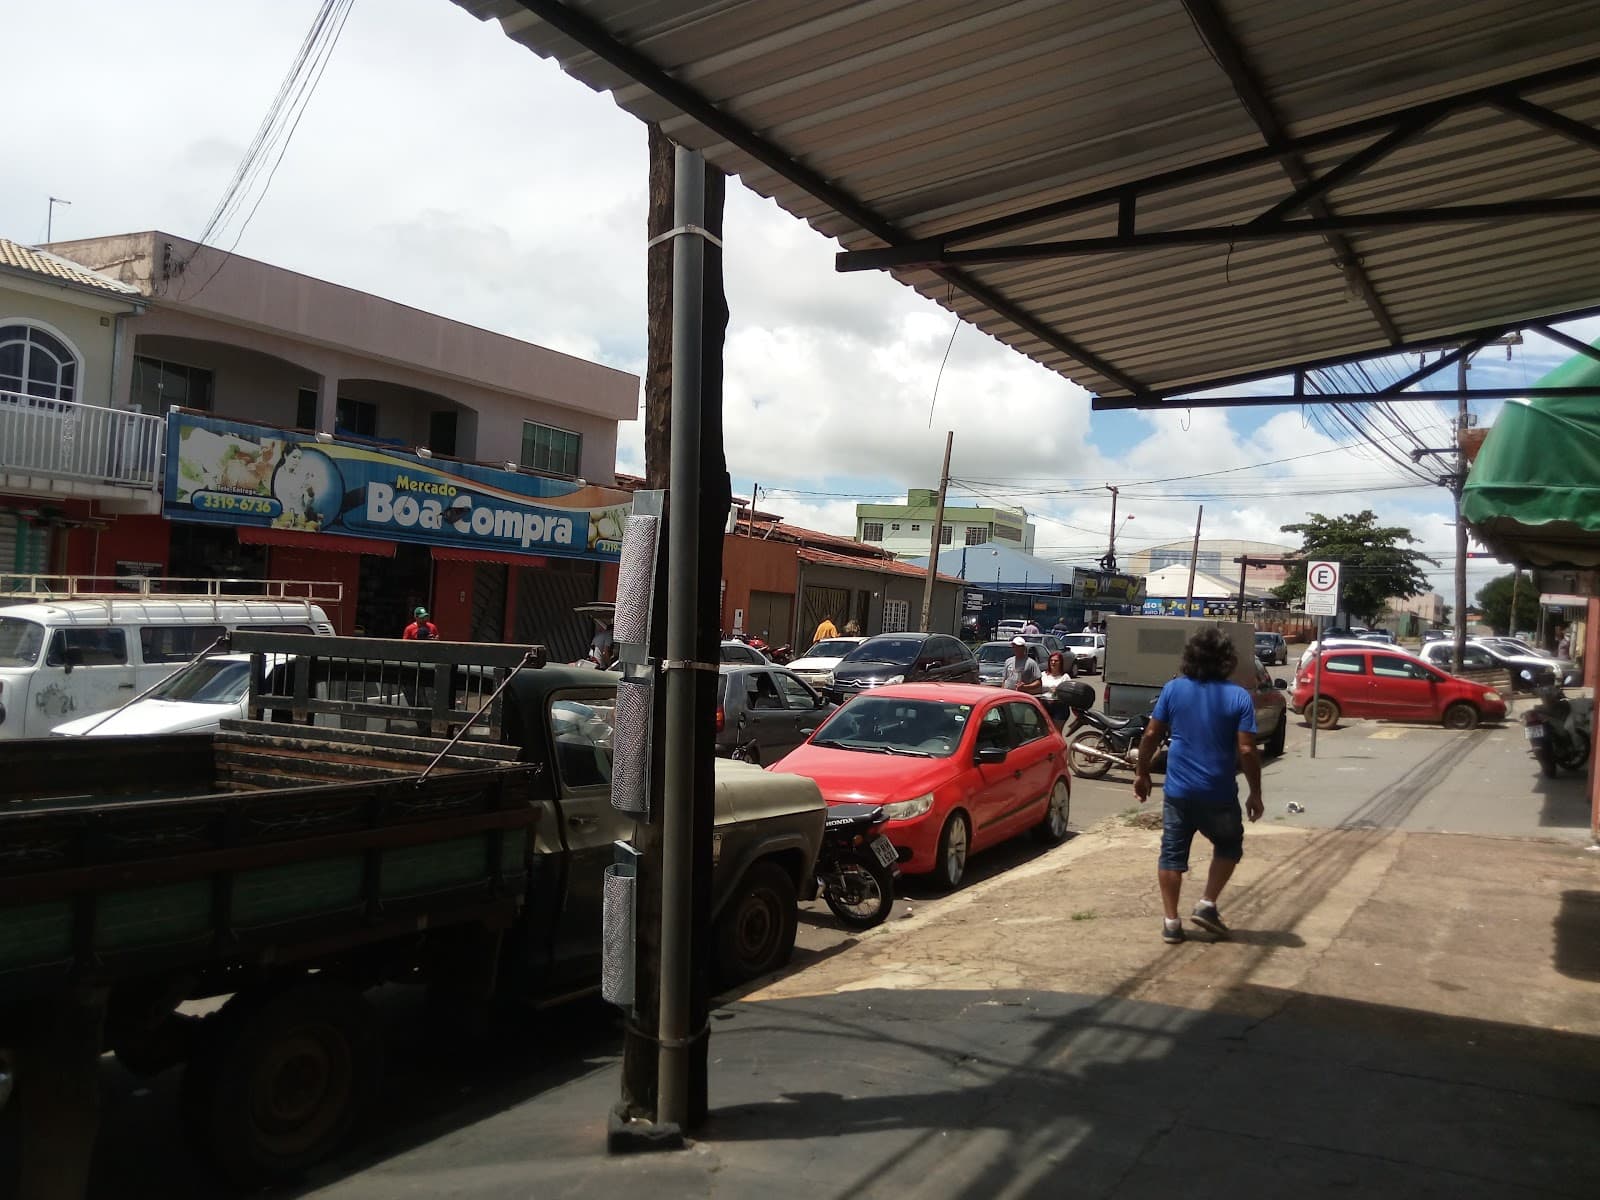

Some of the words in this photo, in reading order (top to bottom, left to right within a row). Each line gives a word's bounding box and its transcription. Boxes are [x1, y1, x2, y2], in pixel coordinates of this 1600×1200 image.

[396, 475, 457, 496] Mercado
[203, 494, 272, 513] 3319-6736
[367, 481, 442, 529] Boa
[1318, 570, 1329, 584] E
[825, 817, 855, 827] HONDA
